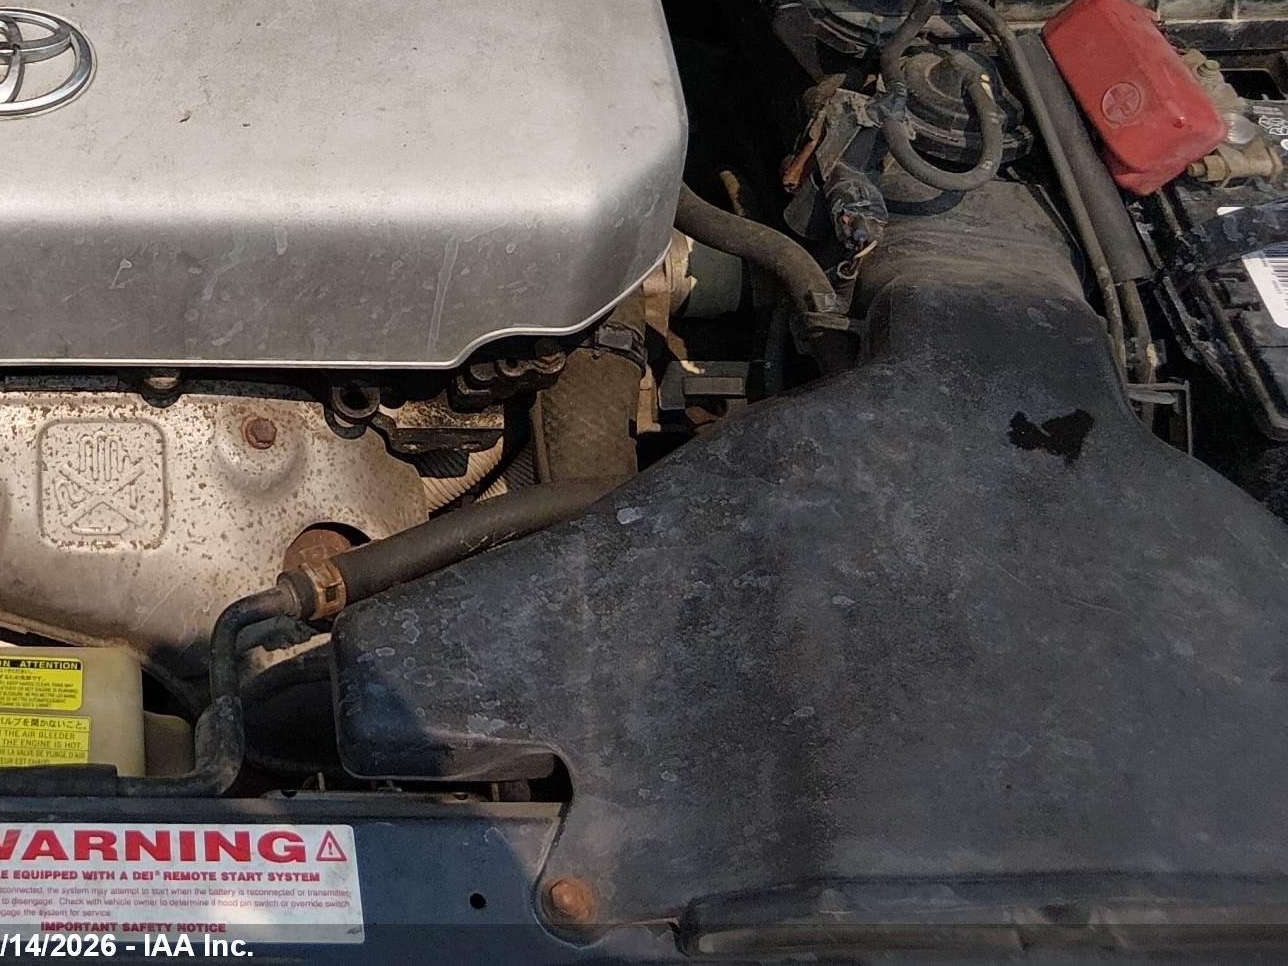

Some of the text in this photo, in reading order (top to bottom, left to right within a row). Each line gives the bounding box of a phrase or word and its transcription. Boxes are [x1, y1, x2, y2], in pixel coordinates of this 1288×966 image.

[20, 660, 78, 670] ATTENTION
[4, 729, 20, 737] THE
[22, 730, 36, 738] AIR
[3, 738, 16, 746] THE
[21, 739, 51, 747] ENGINE
[13, 870, 78, 881] EQUIPPED
[82, 871, 115, 881] WITH
[120, 871, 128, 881] A
[163, 871, 217, 882] REMOTE
[221, 871, 263, 882] START
[267, 872, 321, 883] SYSTEM
[61, 888, 90, 896] system
[110, 887, 139, 896] attempt
[171, 887, 192, 895] when
[194, 888, 207, 896] the
[209, 888, 236, 898] battery
[247, 889, 294, 898] reconnected
[59, 897, 84, 906] Check
[86, 898, 102, 906] with
[103, 898, 132, 906] vehicle
[159, 899, 168, 907] to
[169, 899, 210, 907] determine
[217, 899, 238, 907] hood
[239, 900, 252, 909] pin
[254, 900, 279, 908] switch
[290, 900, 323, 909] override
[324, 900, 351, 909] switch
[38, 909, 67, 918] system
[41, 922, 226, 933] IMPORTANT SAFETY NOTICE
